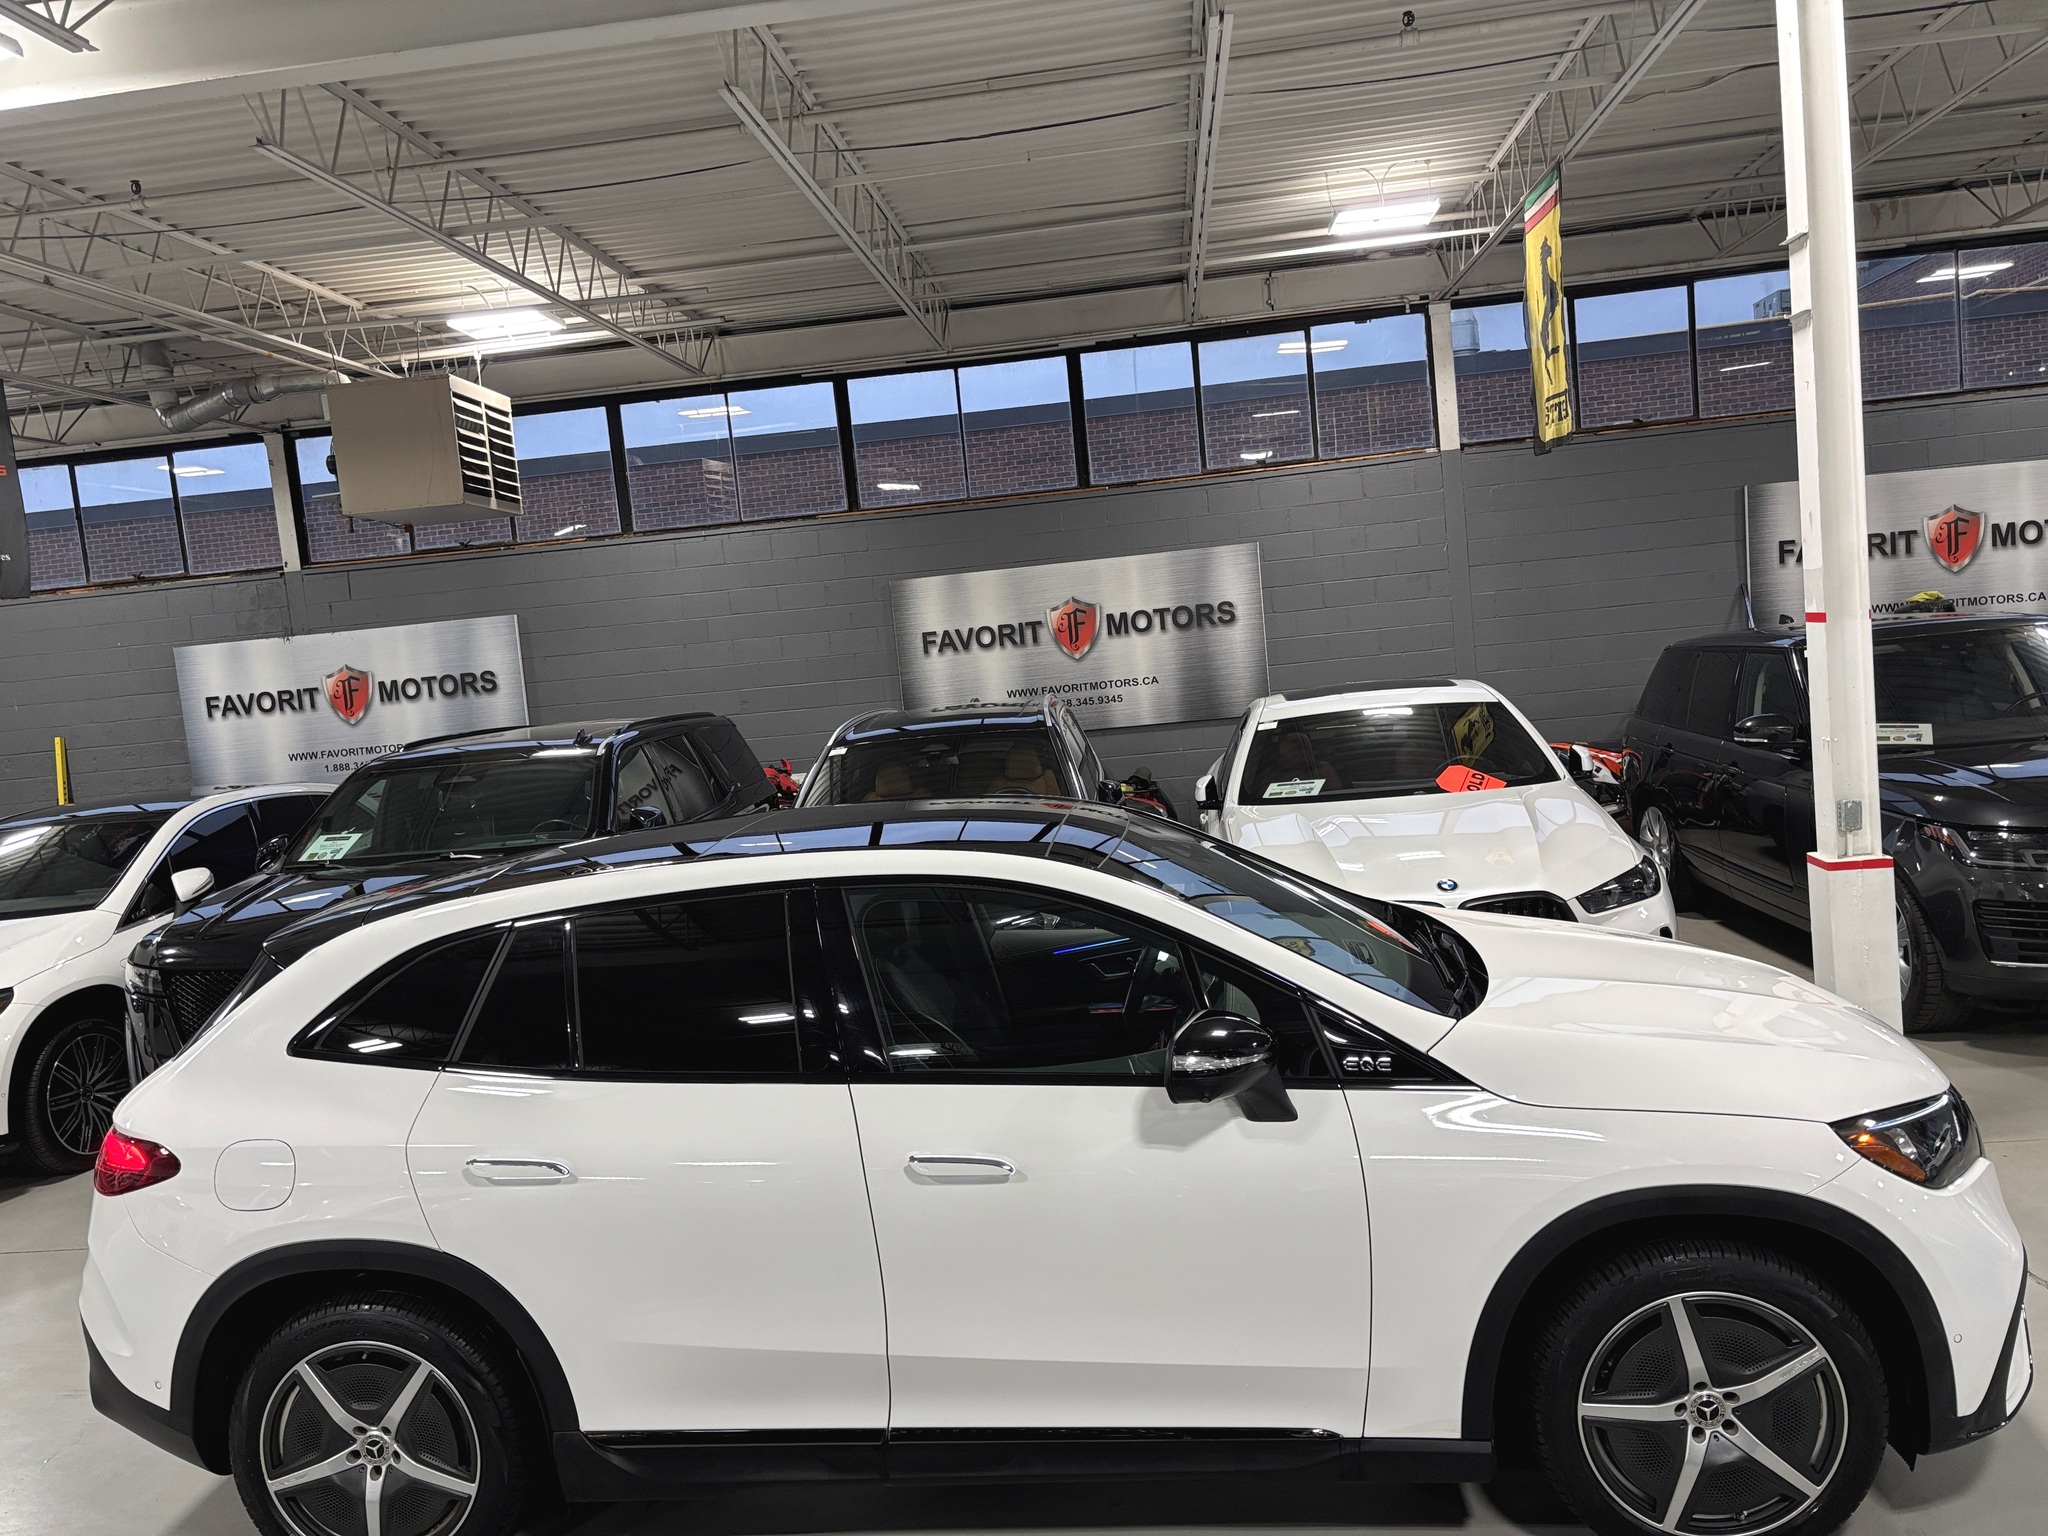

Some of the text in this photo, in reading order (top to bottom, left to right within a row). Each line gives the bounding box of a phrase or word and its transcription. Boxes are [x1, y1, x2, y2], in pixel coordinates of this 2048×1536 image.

[1778, 530, 1917, 564] FRIT
[922, 620, 1043, 654] FAVORIT
[1106, 601, 1236, 635] MOTORS
[206, 686, 319, 718] FAVORIT
[378, 670, 498, 703] MOTORS
[1006, 676, 1159, 698] WWW.FAVORITMOTORS.CA
[1061, 694, 1123, 707] 8.345.9345
[288, 743, 406, 761] WWW.FAVORITMOTOR
[324, 761, 369, 773] 1.888.3
[1466, 773, 1485, 791] OLD
[1342, 1056, 1392, 1072] EQE
